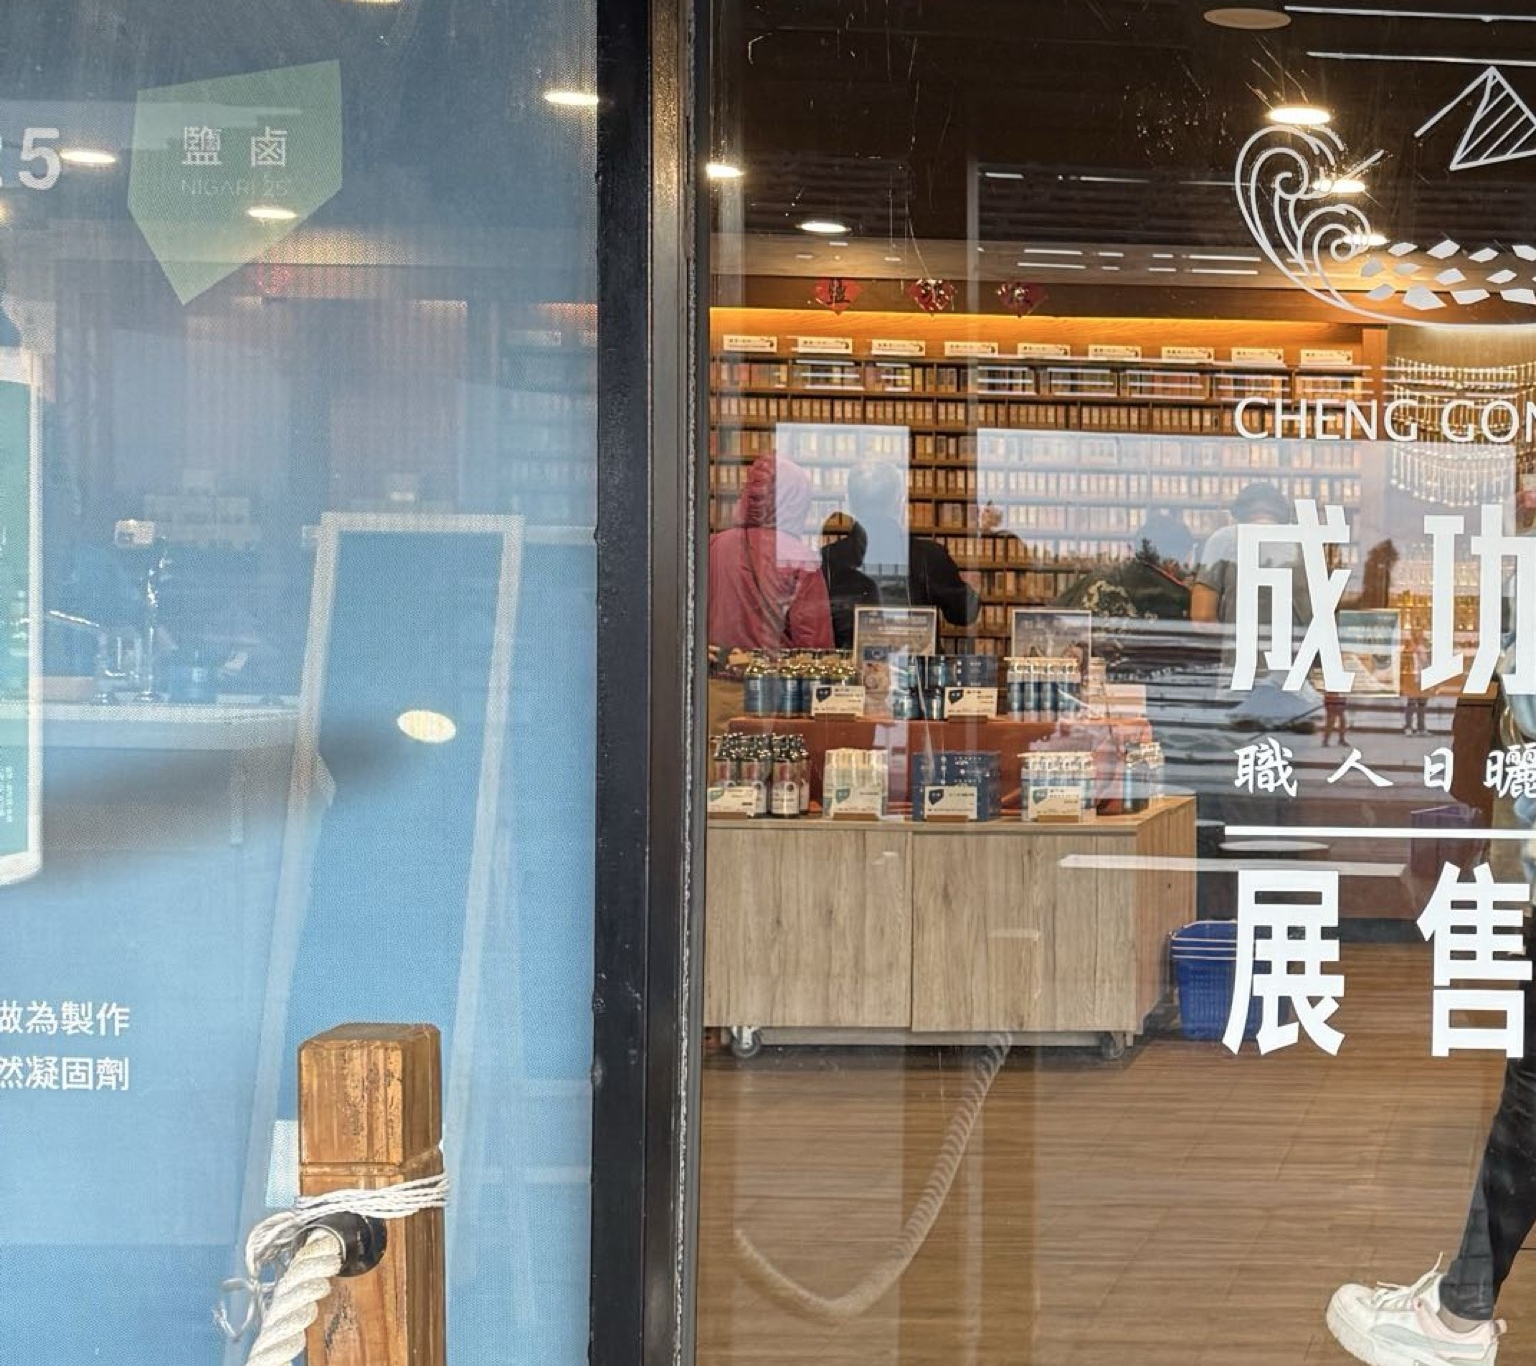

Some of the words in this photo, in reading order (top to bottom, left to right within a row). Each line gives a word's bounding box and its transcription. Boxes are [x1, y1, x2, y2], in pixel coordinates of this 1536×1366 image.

[1235, 397, 1419, 442] CHENG
[0, 1055, 129, 1090] 然凝固劑
